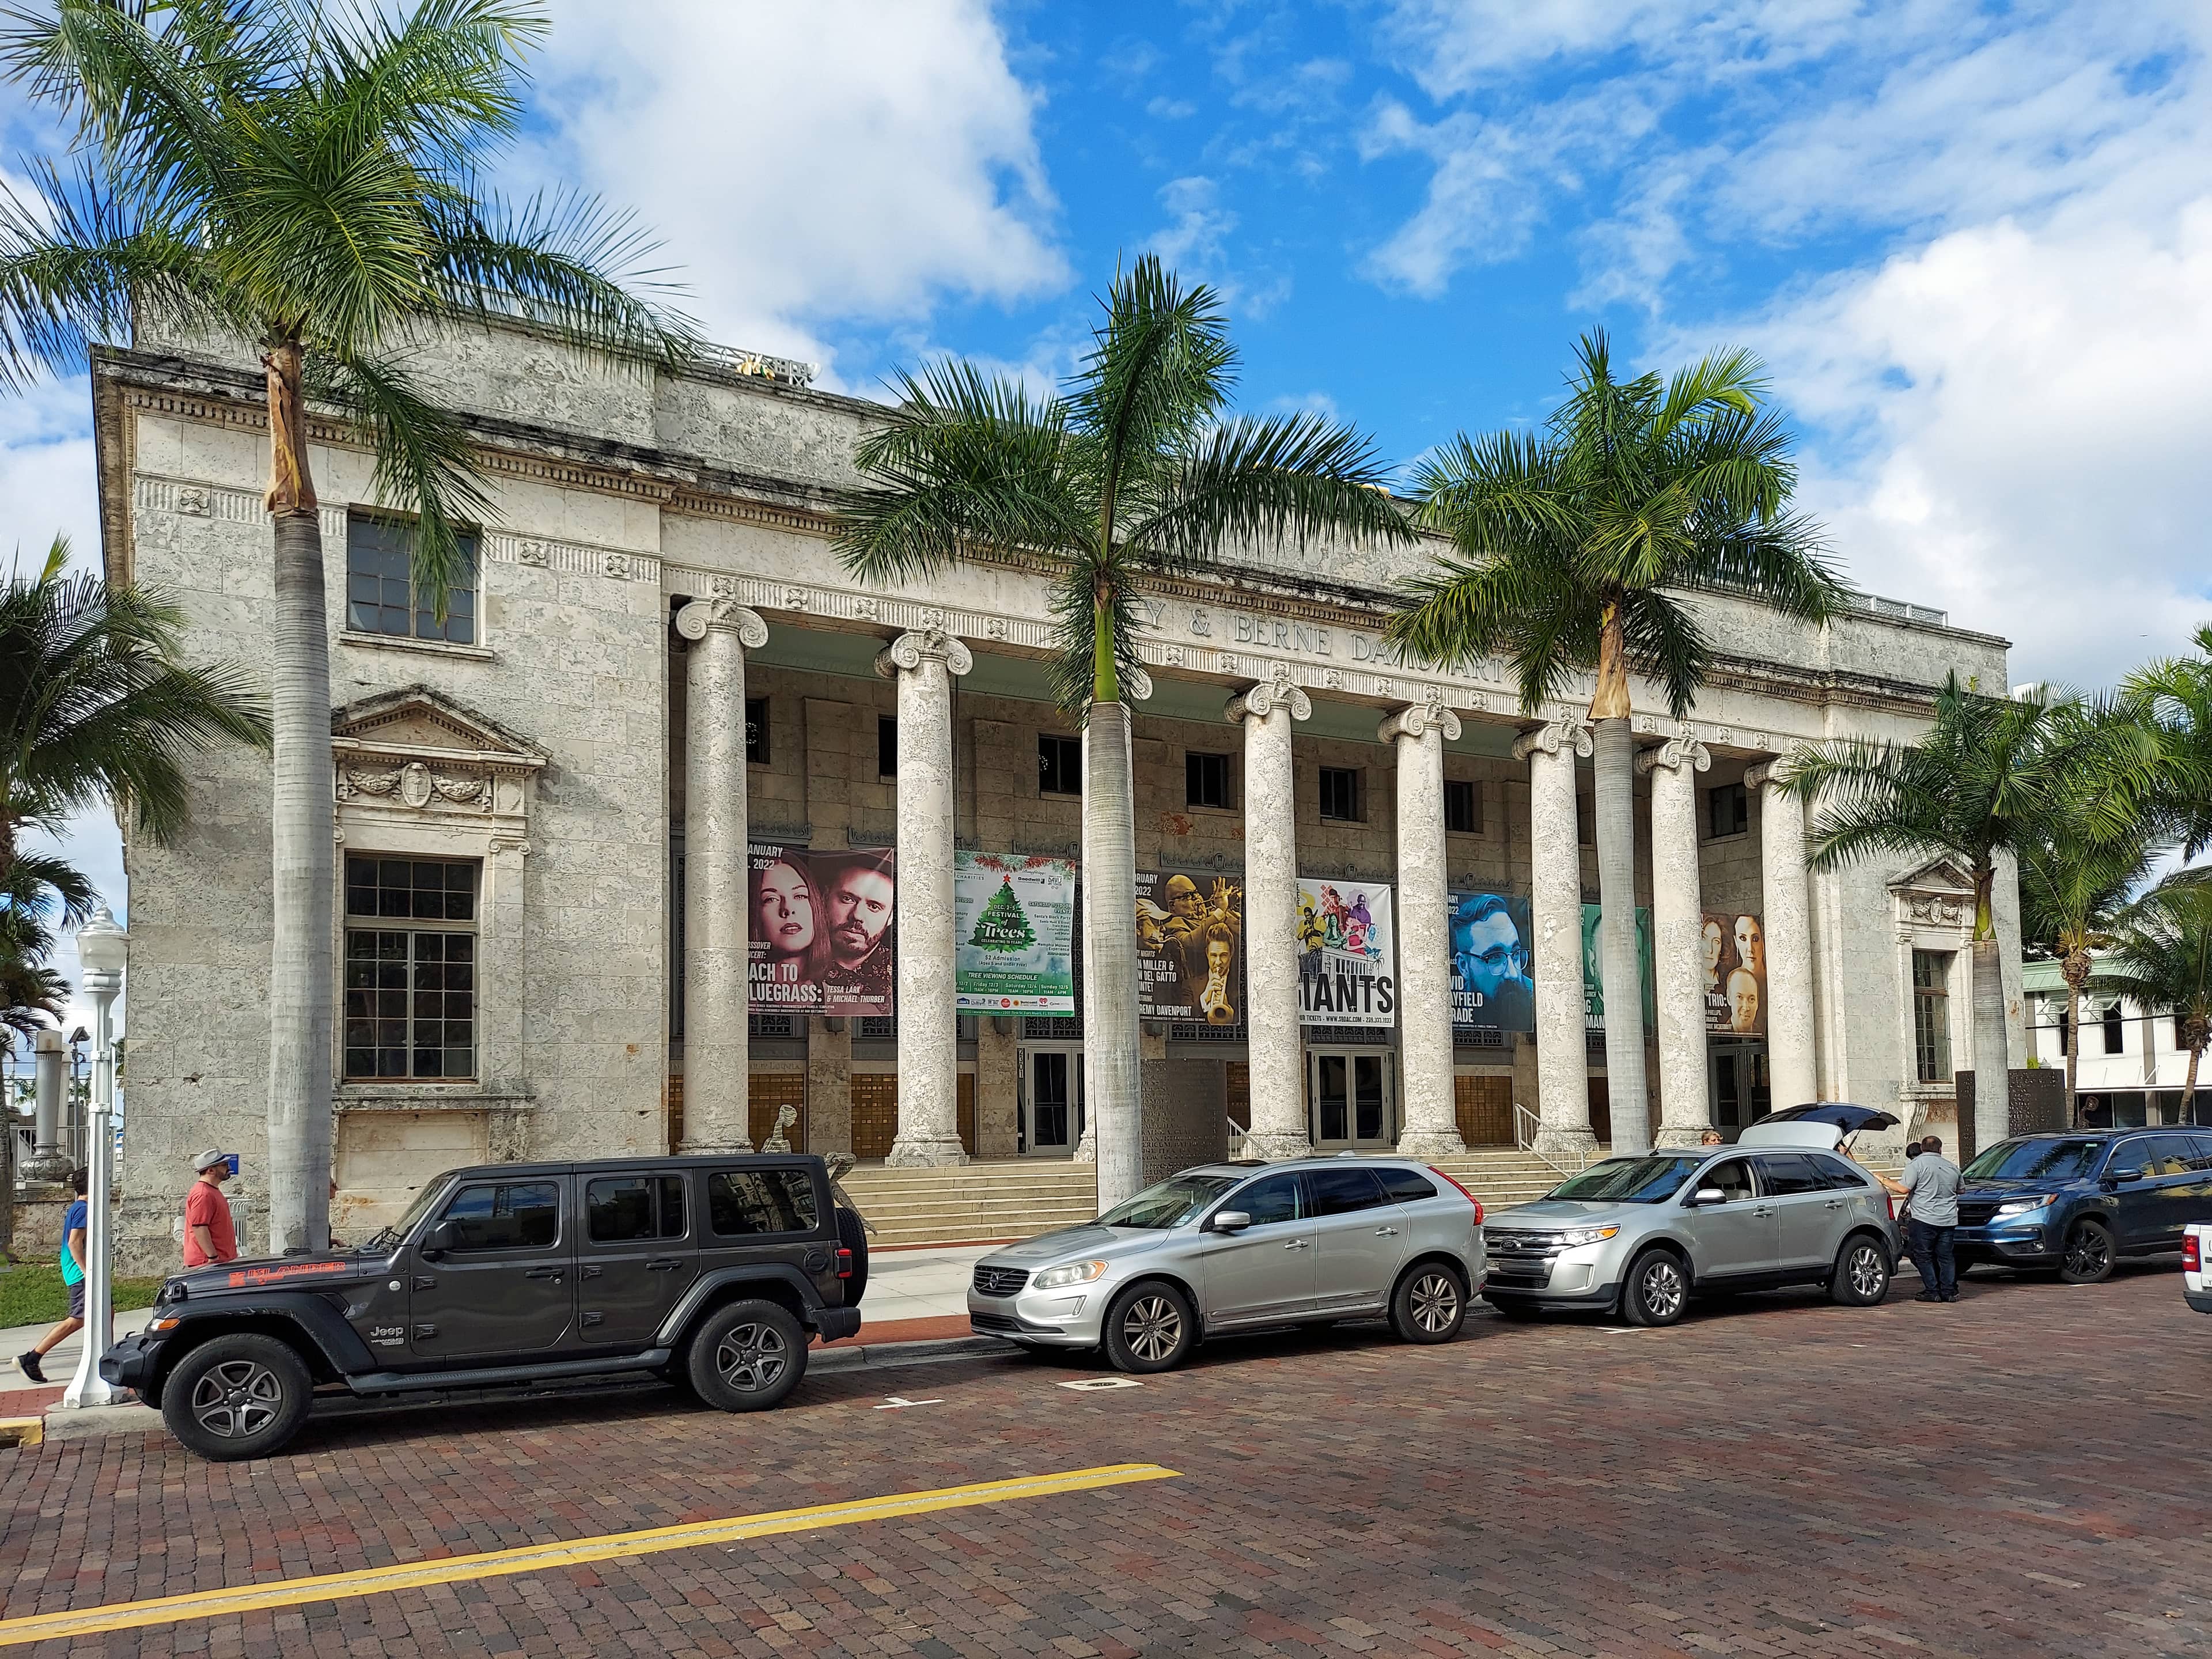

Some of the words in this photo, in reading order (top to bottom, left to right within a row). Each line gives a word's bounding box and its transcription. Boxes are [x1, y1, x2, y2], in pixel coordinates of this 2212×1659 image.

[1189, 608, 1211, 637] &
[1234, 615, 1331, 655] BERNE
[748, 843, 783, 858] ANUARY
[753, 858, 775, 870] 2022
[1137, 873, 1158, 884] RUARY
[1135, 885, 1152, 896] 2022
[981, 922, 1025, 938] Trees
[1143, 959, 1166, 971] MILLER
[1169, 961, 1175, 971] &
[749, 963, 776, 982] ACH
[781, 963, 798, 982] TO
[1143, 971, 1154, 981] DEL
[1156, 971, 1176, 982] GATTO
[749, 983, 823, 1003] LUEGRASS:
[827, 985, 844, 993] TESSA
[846, 985, 861, 994] LARK
[1298, 972, 1393, 1013] IANTS
[832, 994, 858, 1003] MICHAEL
[860, 995, 885, 1003] THURBER
[1708, 993, 1727, 1007] TRIO:
[1139, 1004, 1155, 1015] REMY
[1156, 1005, 1192, 1016] DAVENPORT
[1452, 1007, 1474, 1023] RADE
[370, 1326, 404, 1337] Jeep
